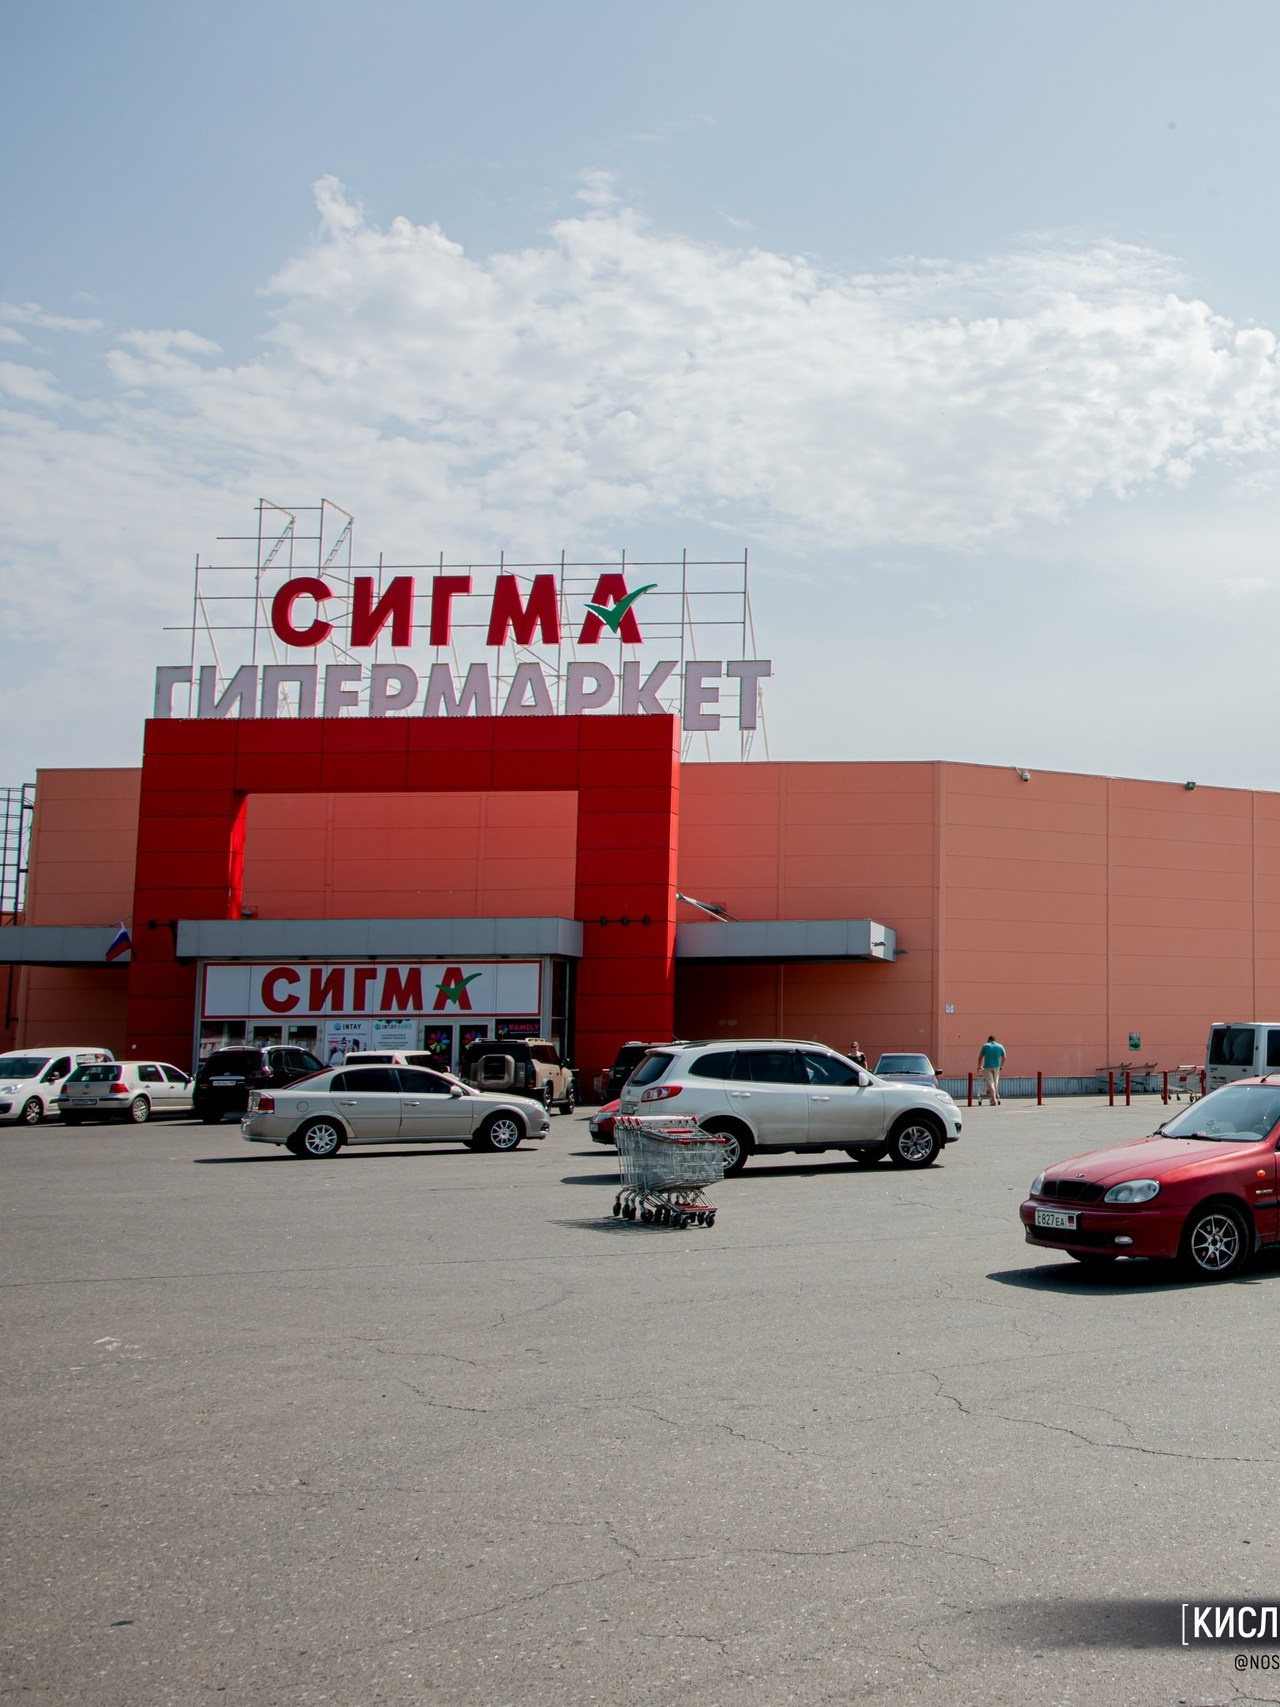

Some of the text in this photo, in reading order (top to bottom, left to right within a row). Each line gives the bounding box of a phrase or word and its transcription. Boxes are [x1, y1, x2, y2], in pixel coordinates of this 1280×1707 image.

[271, 573, 657, 647] СИГМА
[154, 659, 772, 731] ГИПЕРМАРКЕТ
[261, 967, 481, 1014] СИГМА
[509, 1023, 540, 1031] FAMILY
